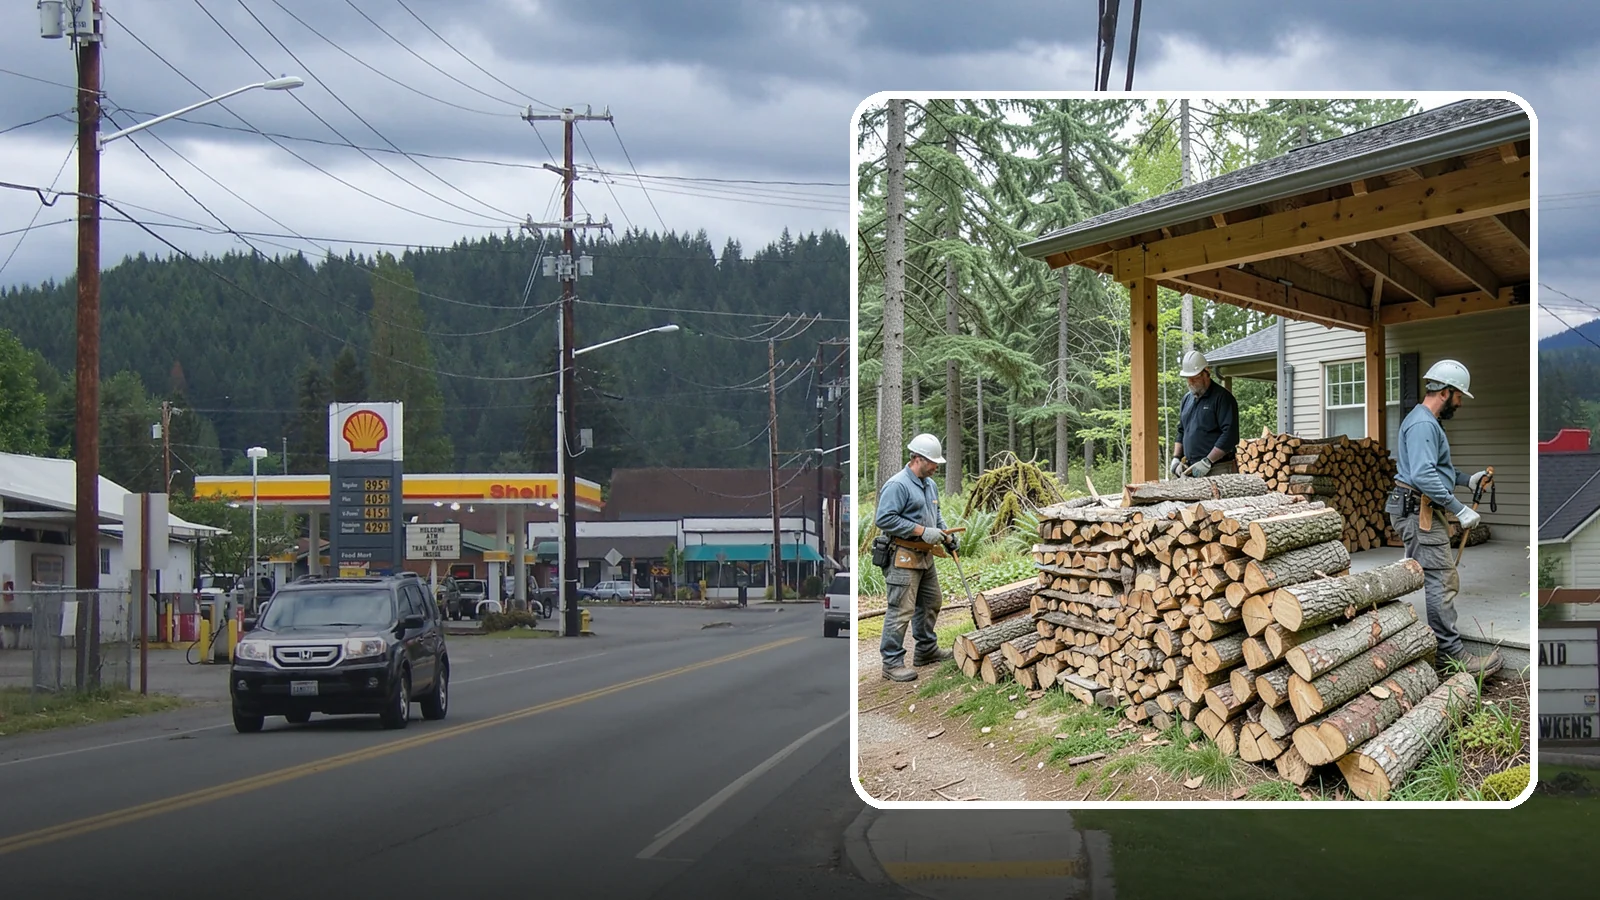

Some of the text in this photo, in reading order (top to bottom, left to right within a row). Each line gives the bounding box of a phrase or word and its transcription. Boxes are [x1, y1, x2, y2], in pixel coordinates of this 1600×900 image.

[366, 480, 383, 490] 395
[490, 484, 547, 499] Shell
[366, 494, 383, 504] 405
[366, 508, 383, 518] 415
[366, 522, 383, 532] 429
